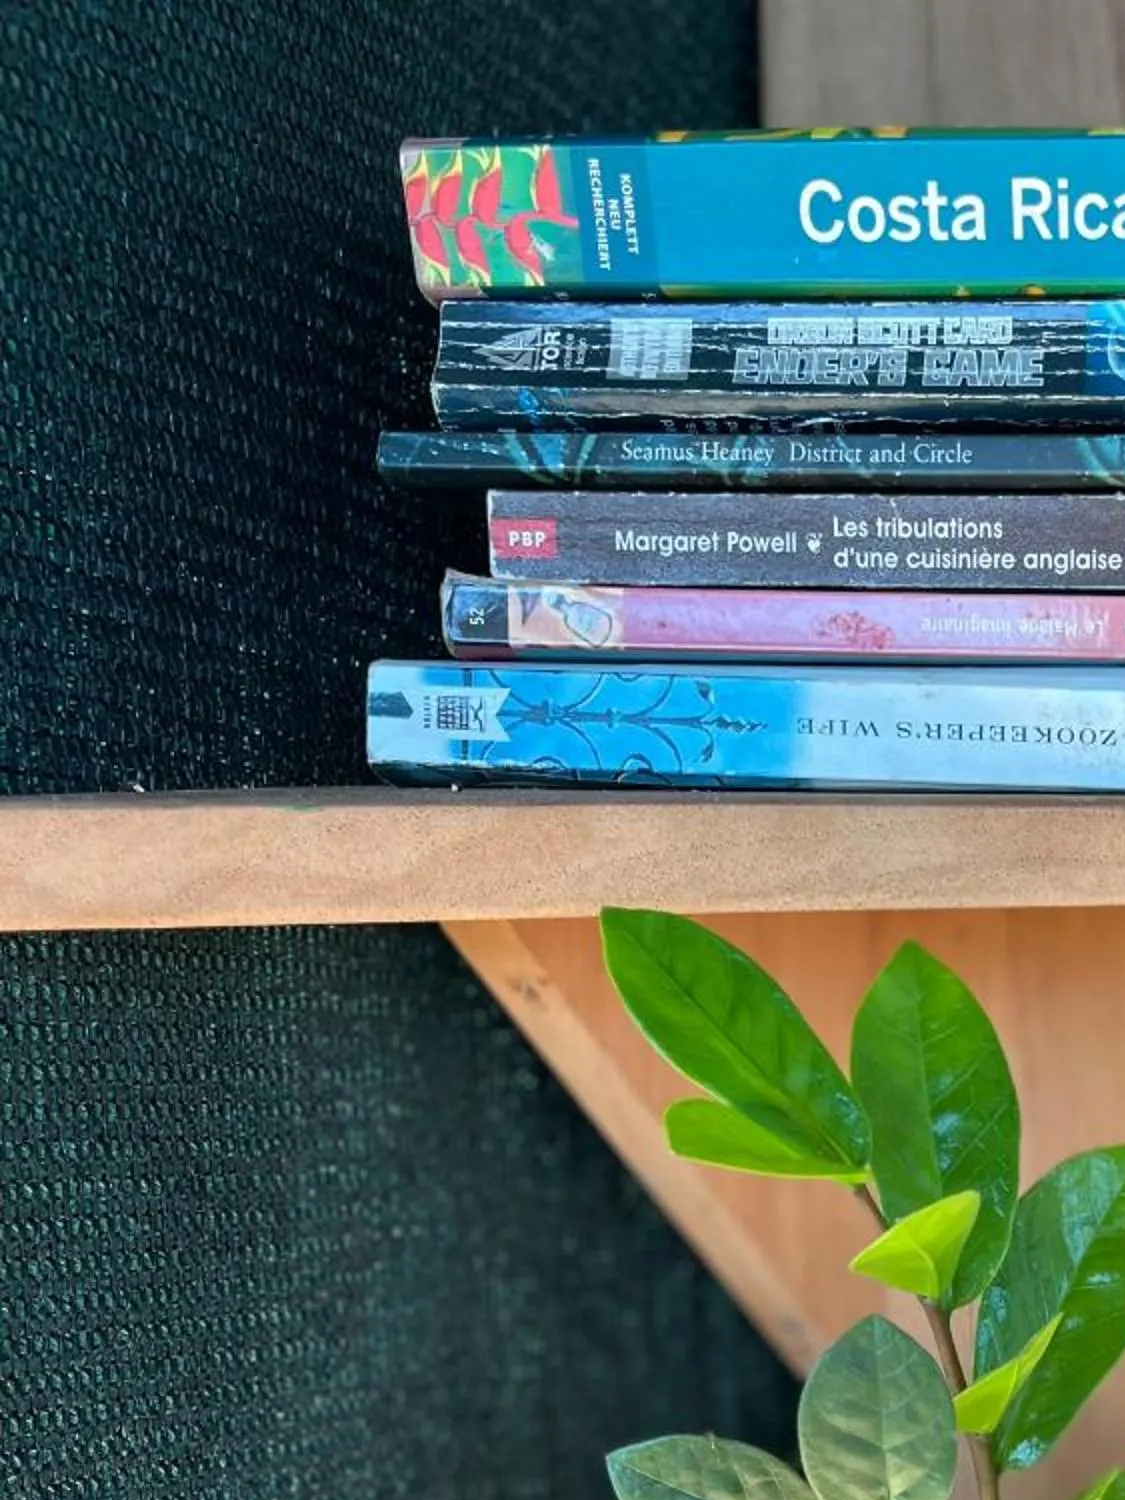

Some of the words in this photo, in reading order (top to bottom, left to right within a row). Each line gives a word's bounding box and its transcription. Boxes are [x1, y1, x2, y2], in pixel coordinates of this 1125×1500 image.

[607, 198, 621, 230] NEU
[619, 173, 639, 254] KOMPLETT
[799, 178, 987, 243] Costa
[541, 330, 562, 371] TOR
[732, 349, 908, 386] ENDER'S
[922, 350, 1045, 387] GAME
[619, 440, 694, 462] Seamus
[700, 441, 775, 467] Heaney
[789, 441, 862, 464] District
[869, 443, 906, 464] and
[913, 443, 973, 465] Circle
[508, 532, 546, 548] PBP
[614, 529, 720, 554] Margaret
[726, 531, 798, 553] Powell
[833, 516, 869, 538] Les
[875, 517, 1003, 540] tribulations
[833, 546, 899, 570] d'une
[906, 546, 1017, 571] cuisinière
[1023, 549, 1124, 575] anglaise
[469, 607, 485, 626] 52
[1018, 615, 1079, 639] Malade
[1084, 616, 1105, 639] Le
[796, 717, 881, 738] WIFE
[896, 720, 1119, 747] ZOOKEEPER'S
